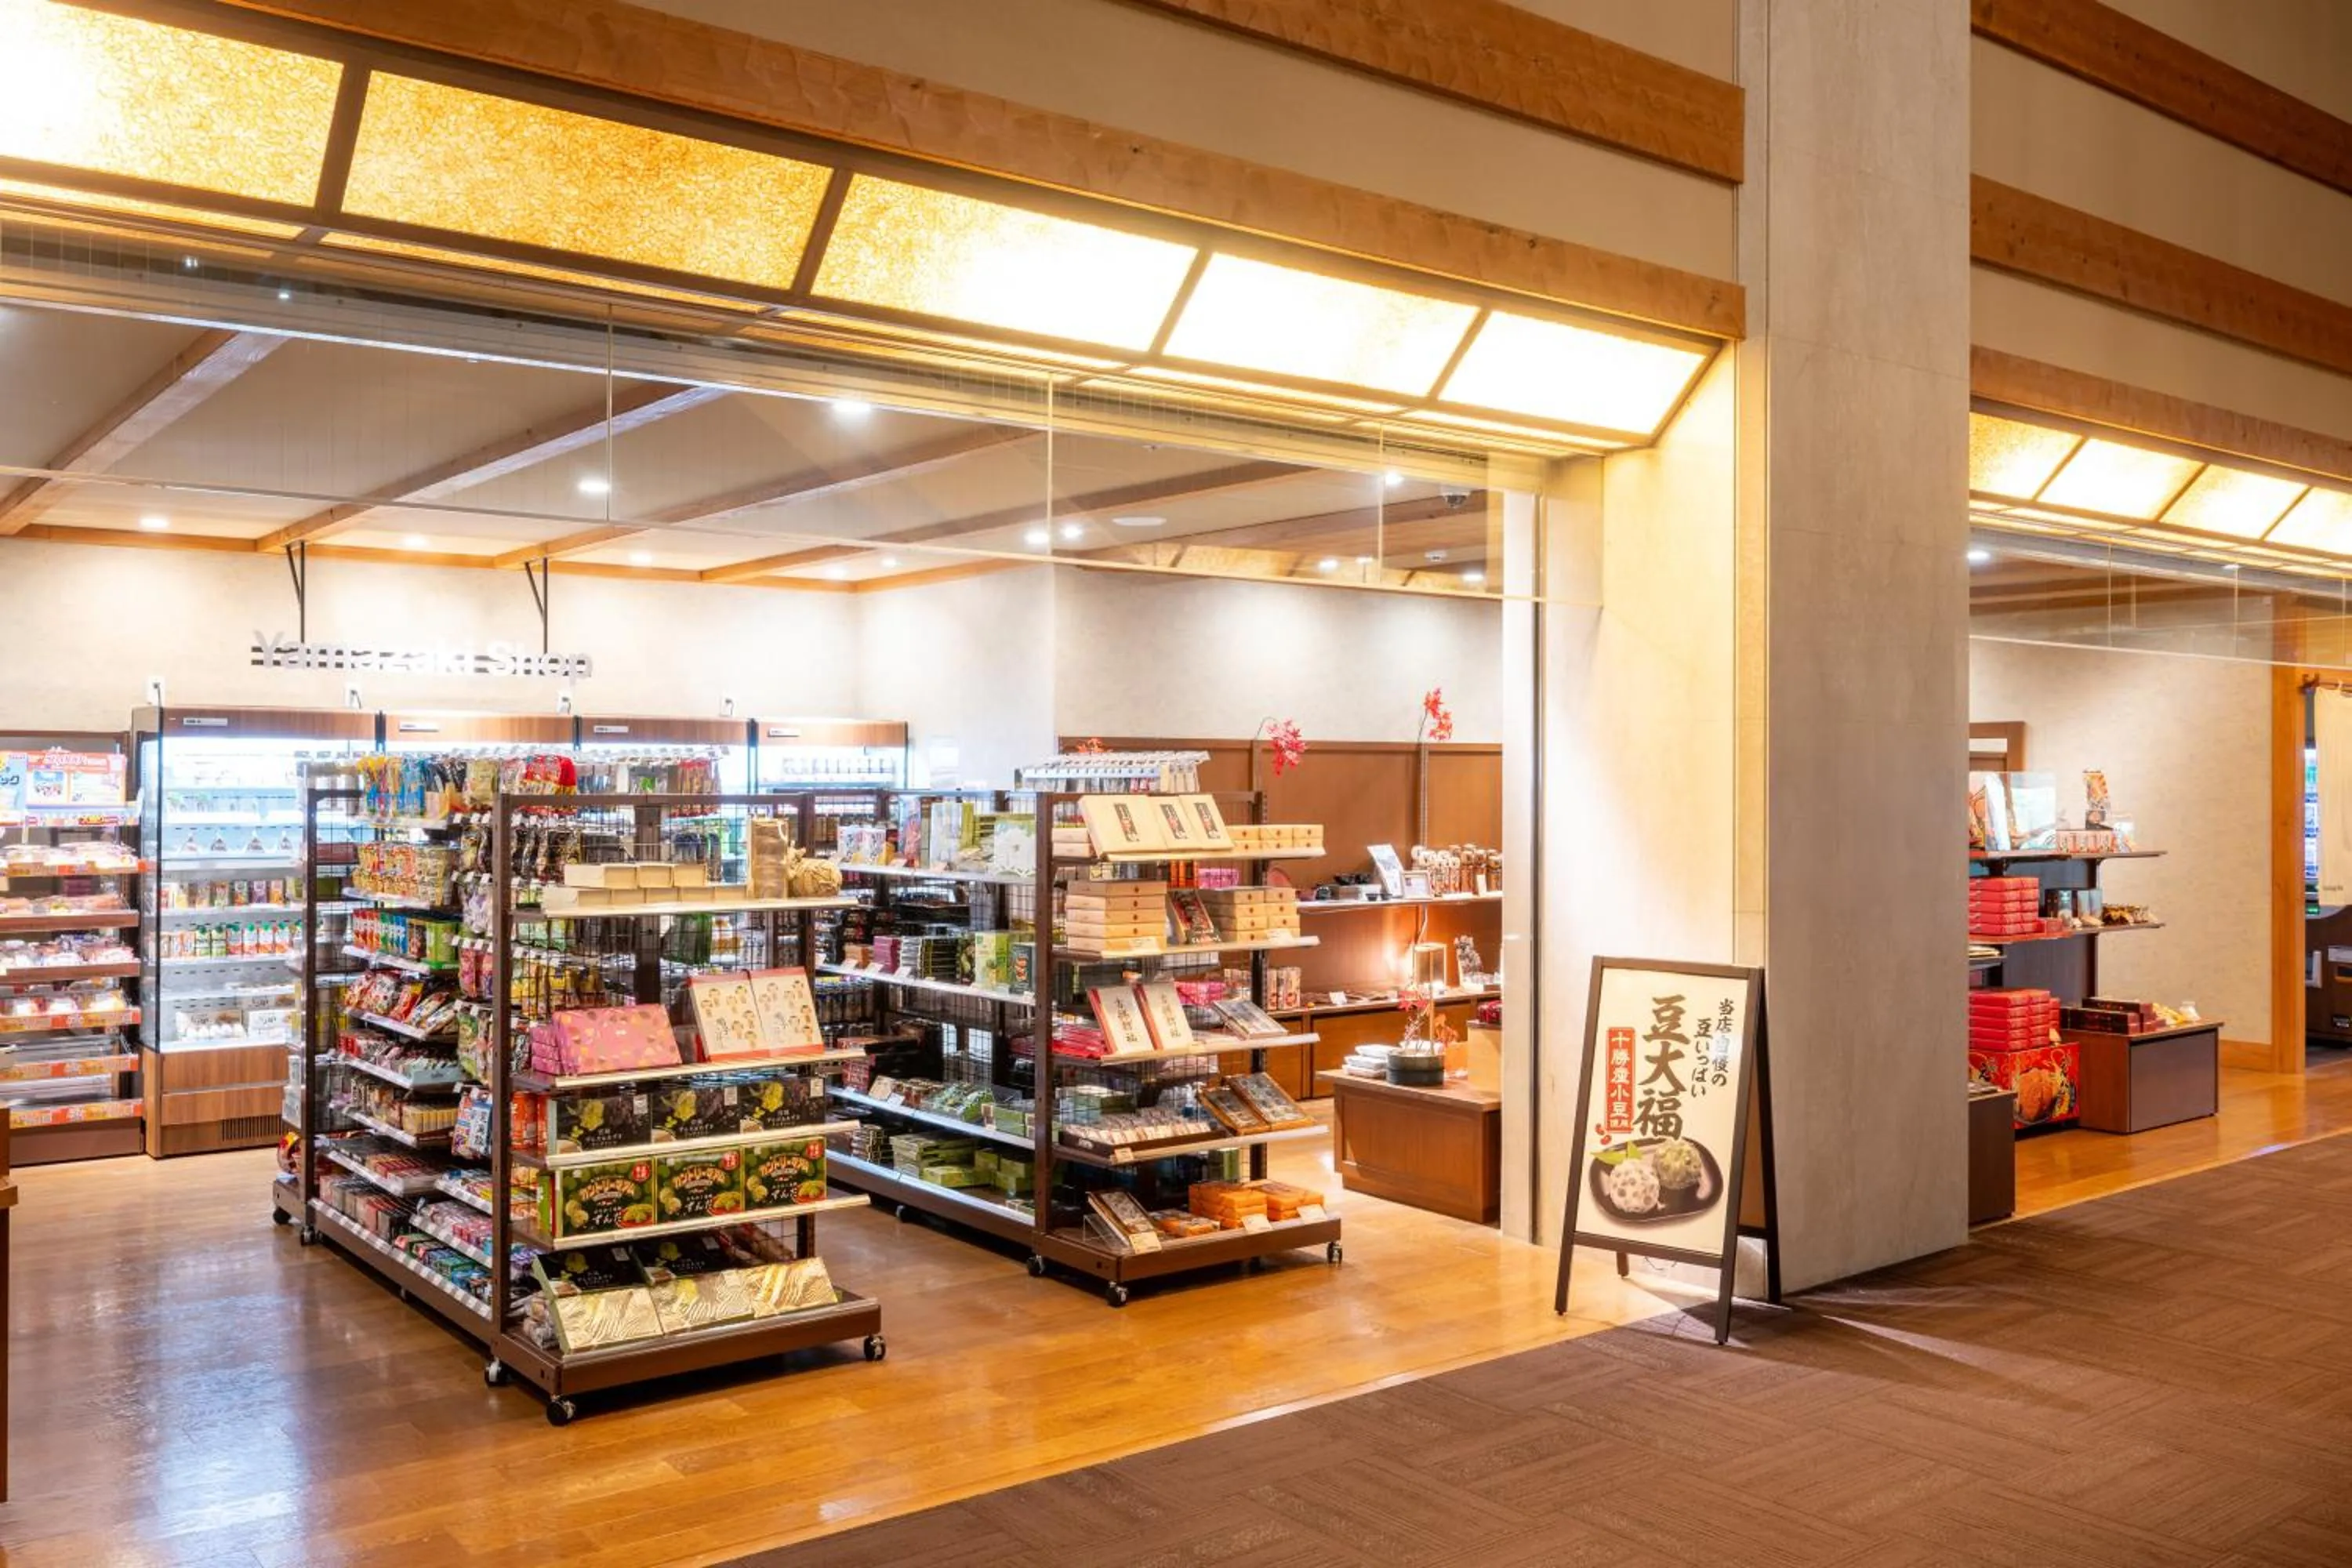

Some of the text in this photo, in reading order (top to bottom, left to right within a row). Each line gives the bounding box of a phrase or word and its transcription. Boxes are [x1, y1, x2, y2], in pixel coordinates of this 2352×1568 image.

[252, 630, 593, 687] Yamazaki Shop
[1633, 994, 1691, 1141] 豆大福
[1691, 1018, 1714, 1098] 豆いっぱい
[1711, 998, 1735, 1087] 当店自慢の
